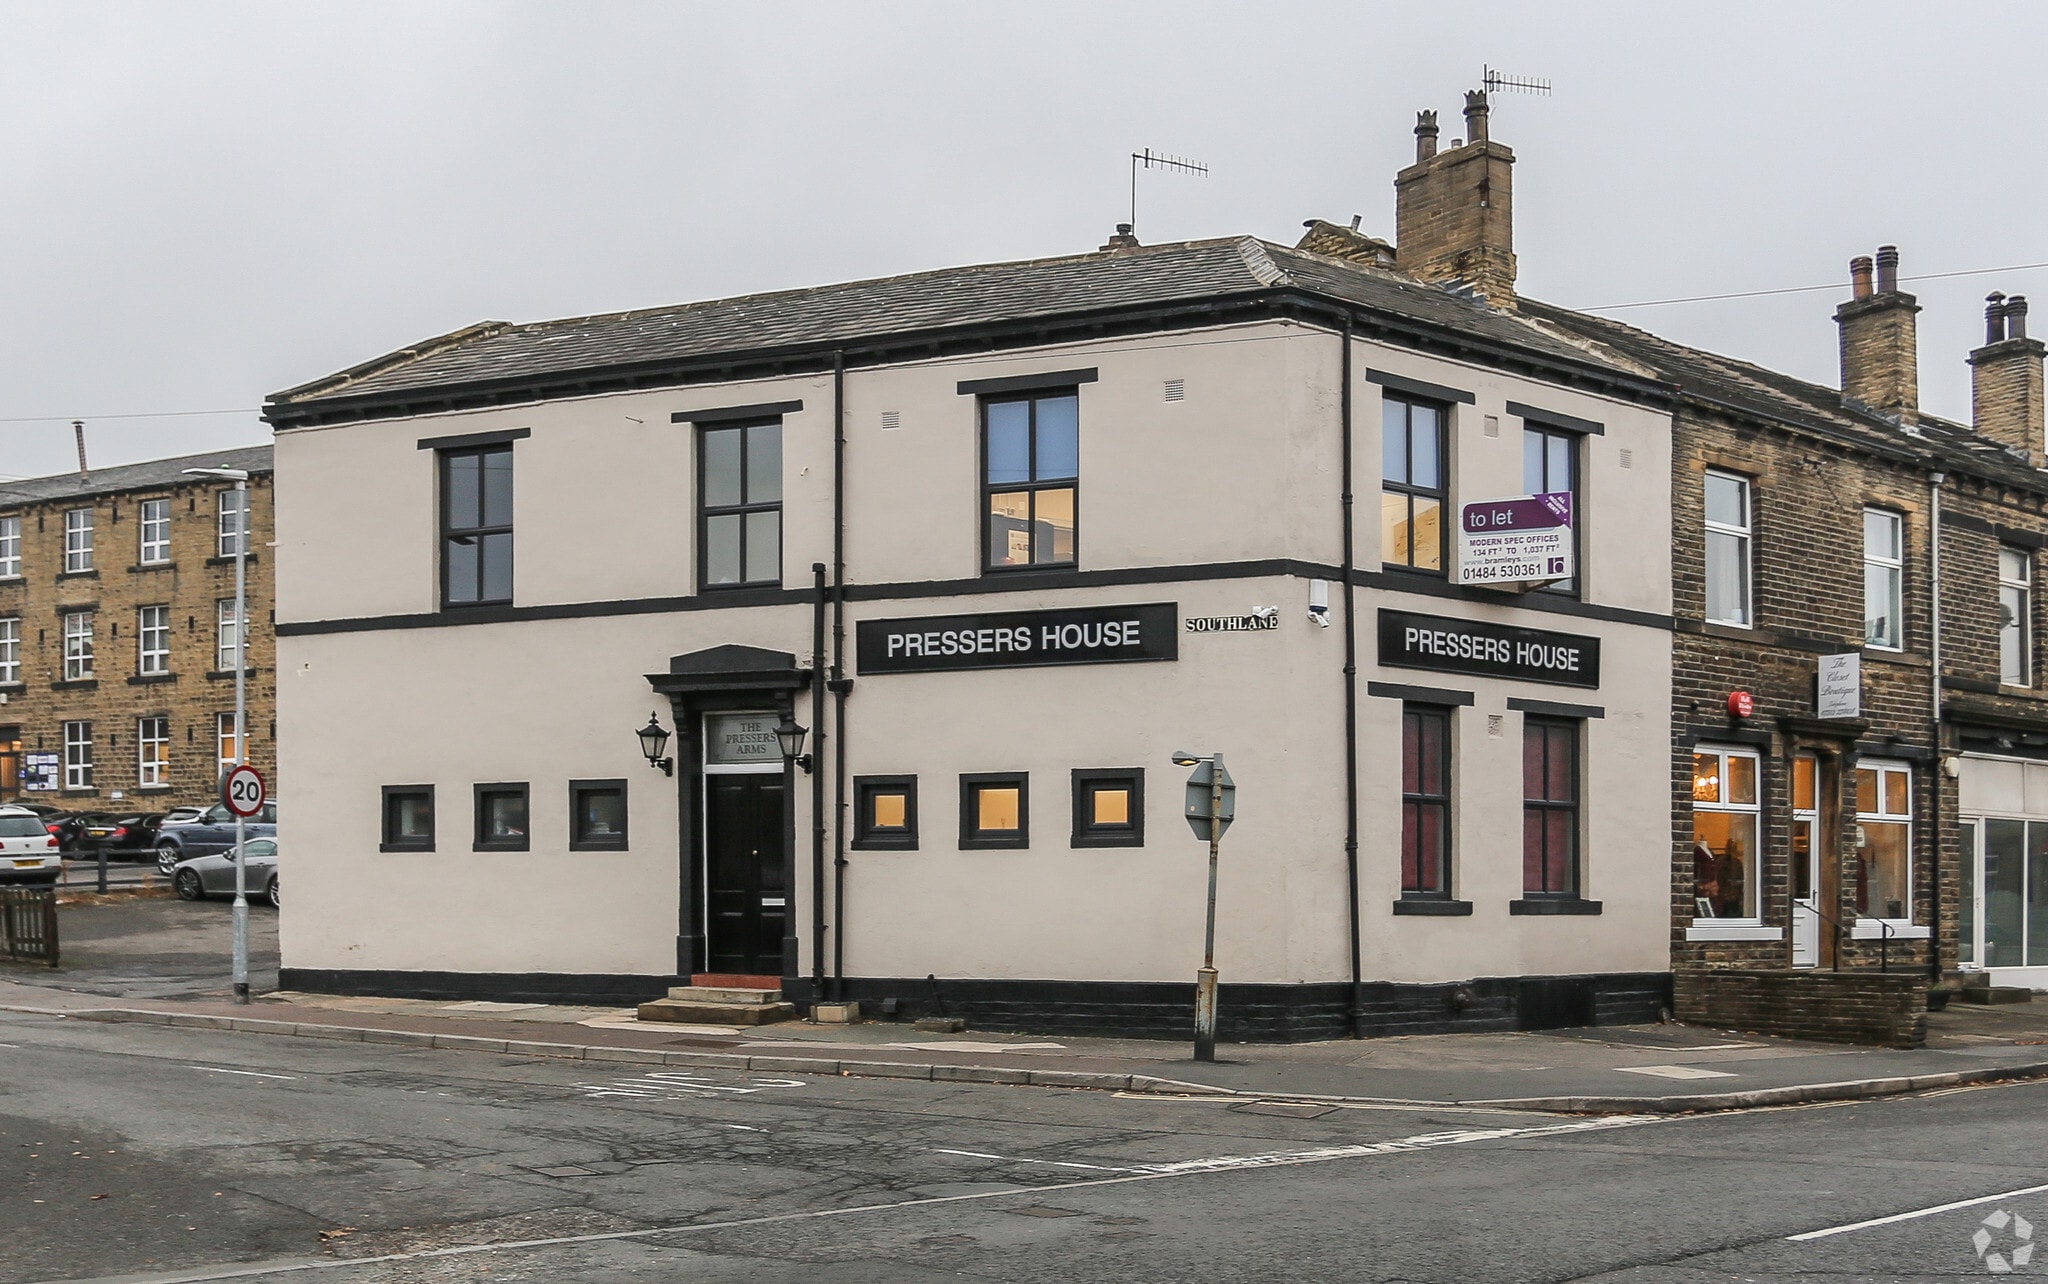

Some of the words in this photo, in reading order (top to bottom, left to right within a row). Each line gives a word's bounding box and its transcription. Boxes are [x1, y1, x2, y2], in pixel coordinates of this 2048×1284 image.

[1469, 512, 1486, 527] to
[1492, 509, 1513, 525] let
[1469, 539, 1502, 547] MODERN
[1504, 537, 1524, 545] SPEC
[1526, 534, 1559, 543] OFFICES
[1523, 546, 1544, 555] 1,037
[1463, 566, 1496, 580] 01484
[1500, 564, 1541, 577] 530361
[888, 626, 1032, 658] PRESSERS
[1042, 620, 1141, 650] HOUSE
[1405, 627, 1510, 663] PRESSERS
[1517, 642, 1579, 671] HOUSE
[741, 722, 761, 732] THE
[726, 733, 777, 744] PRESSERS
[736, 744, 767, 754] ARMS
[232, 779, 260, 802] 20
